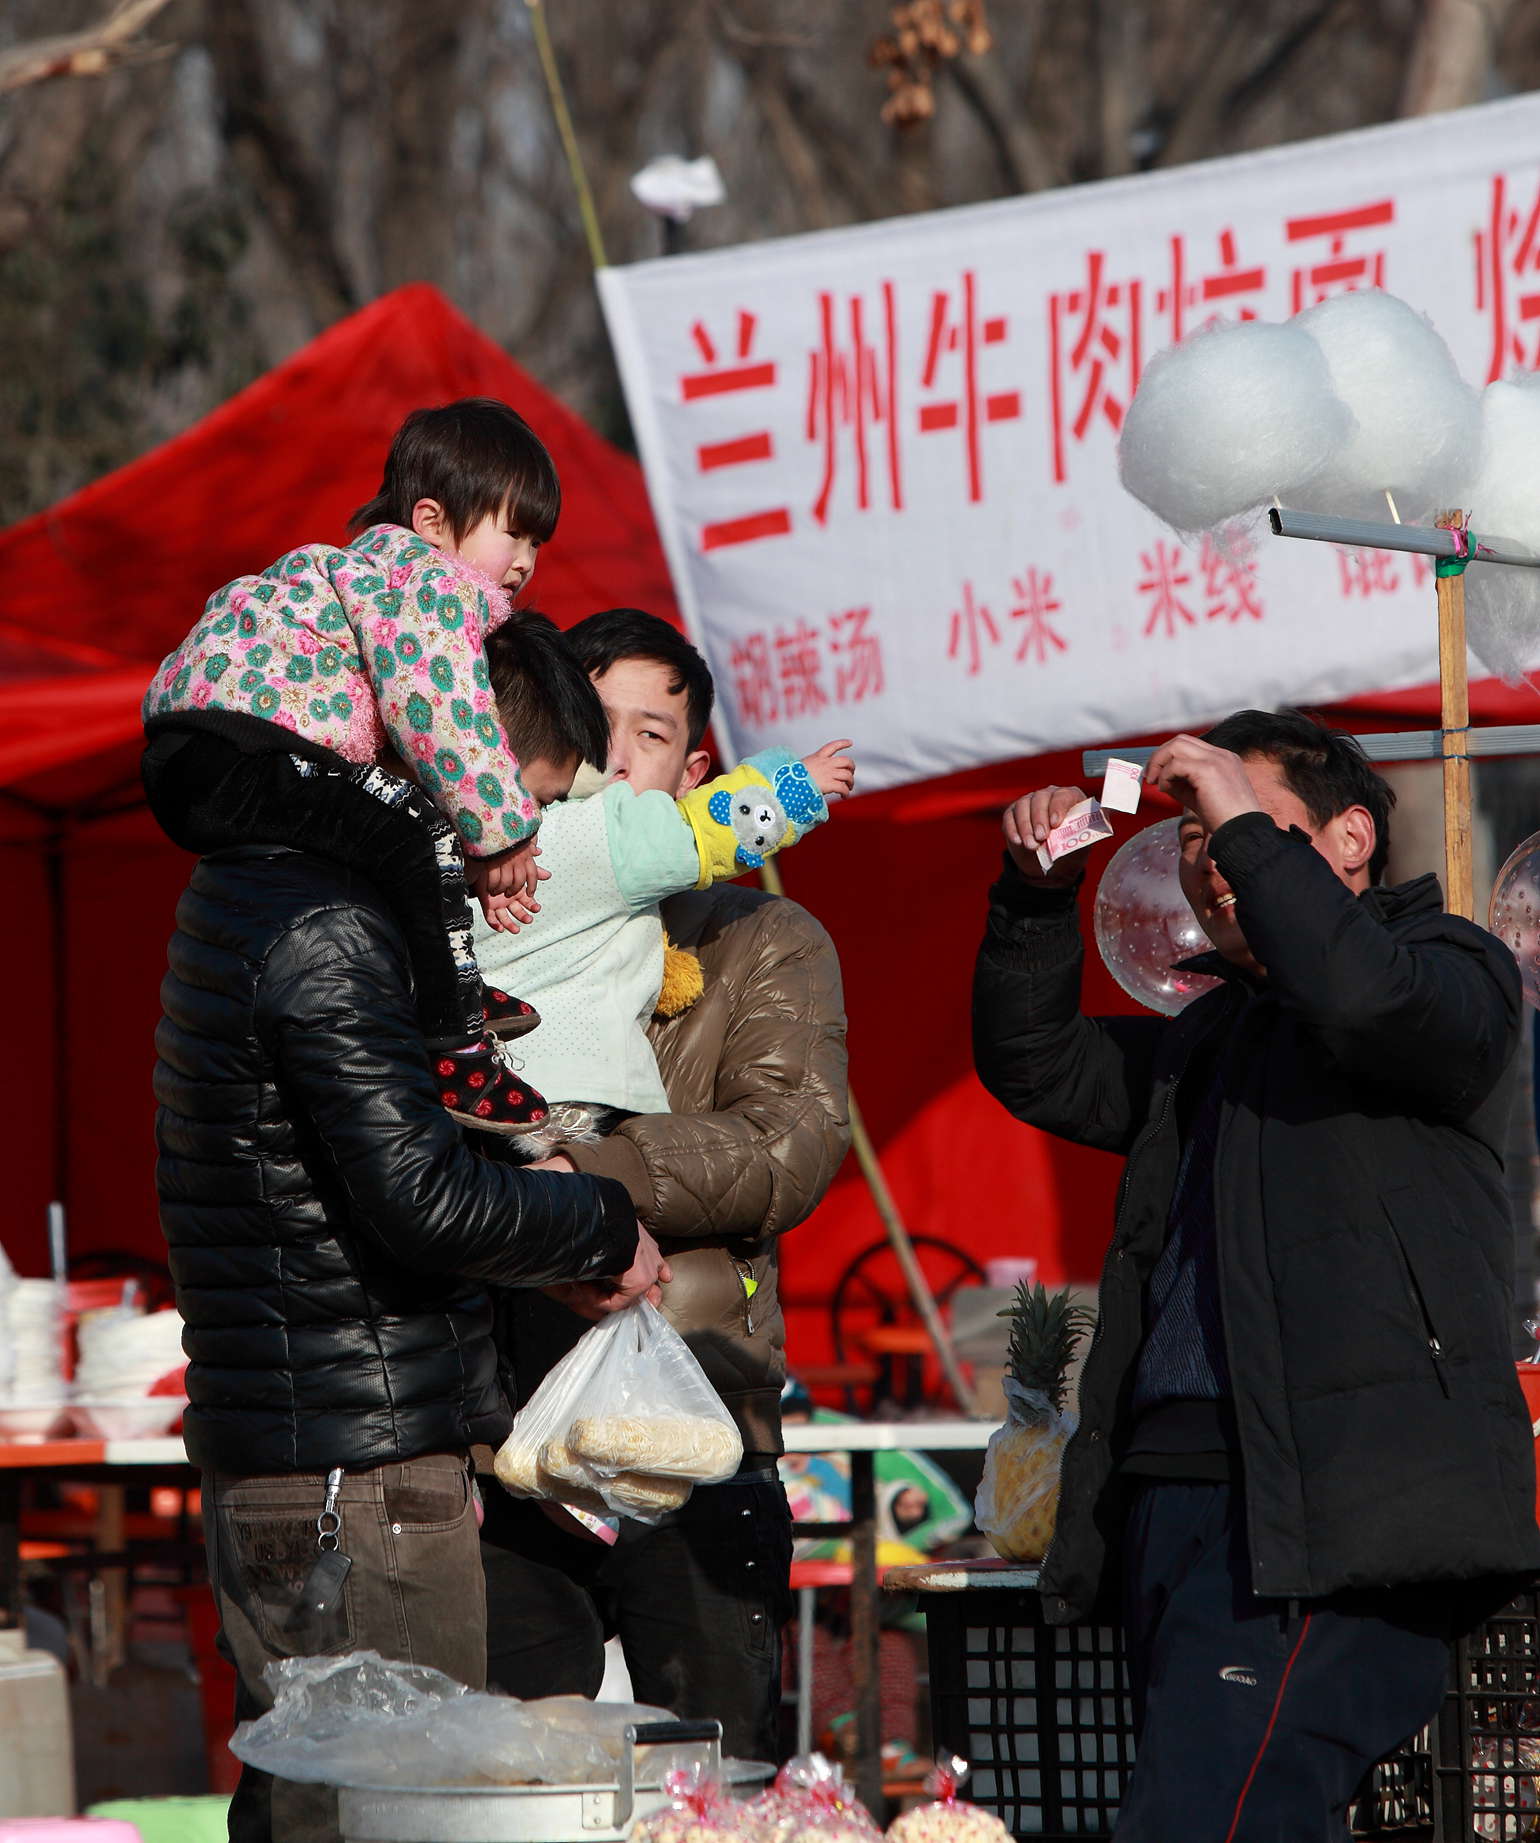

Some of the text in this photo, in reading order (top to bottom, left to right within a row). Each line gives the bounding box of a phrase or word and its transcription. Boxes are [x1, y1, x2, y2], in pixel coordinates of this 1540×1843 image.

[730, 606, 885, 728] 胡辣汤
[947, 566, 1068, 676] 小米
[1136, 532, 1264, 638] 米线
